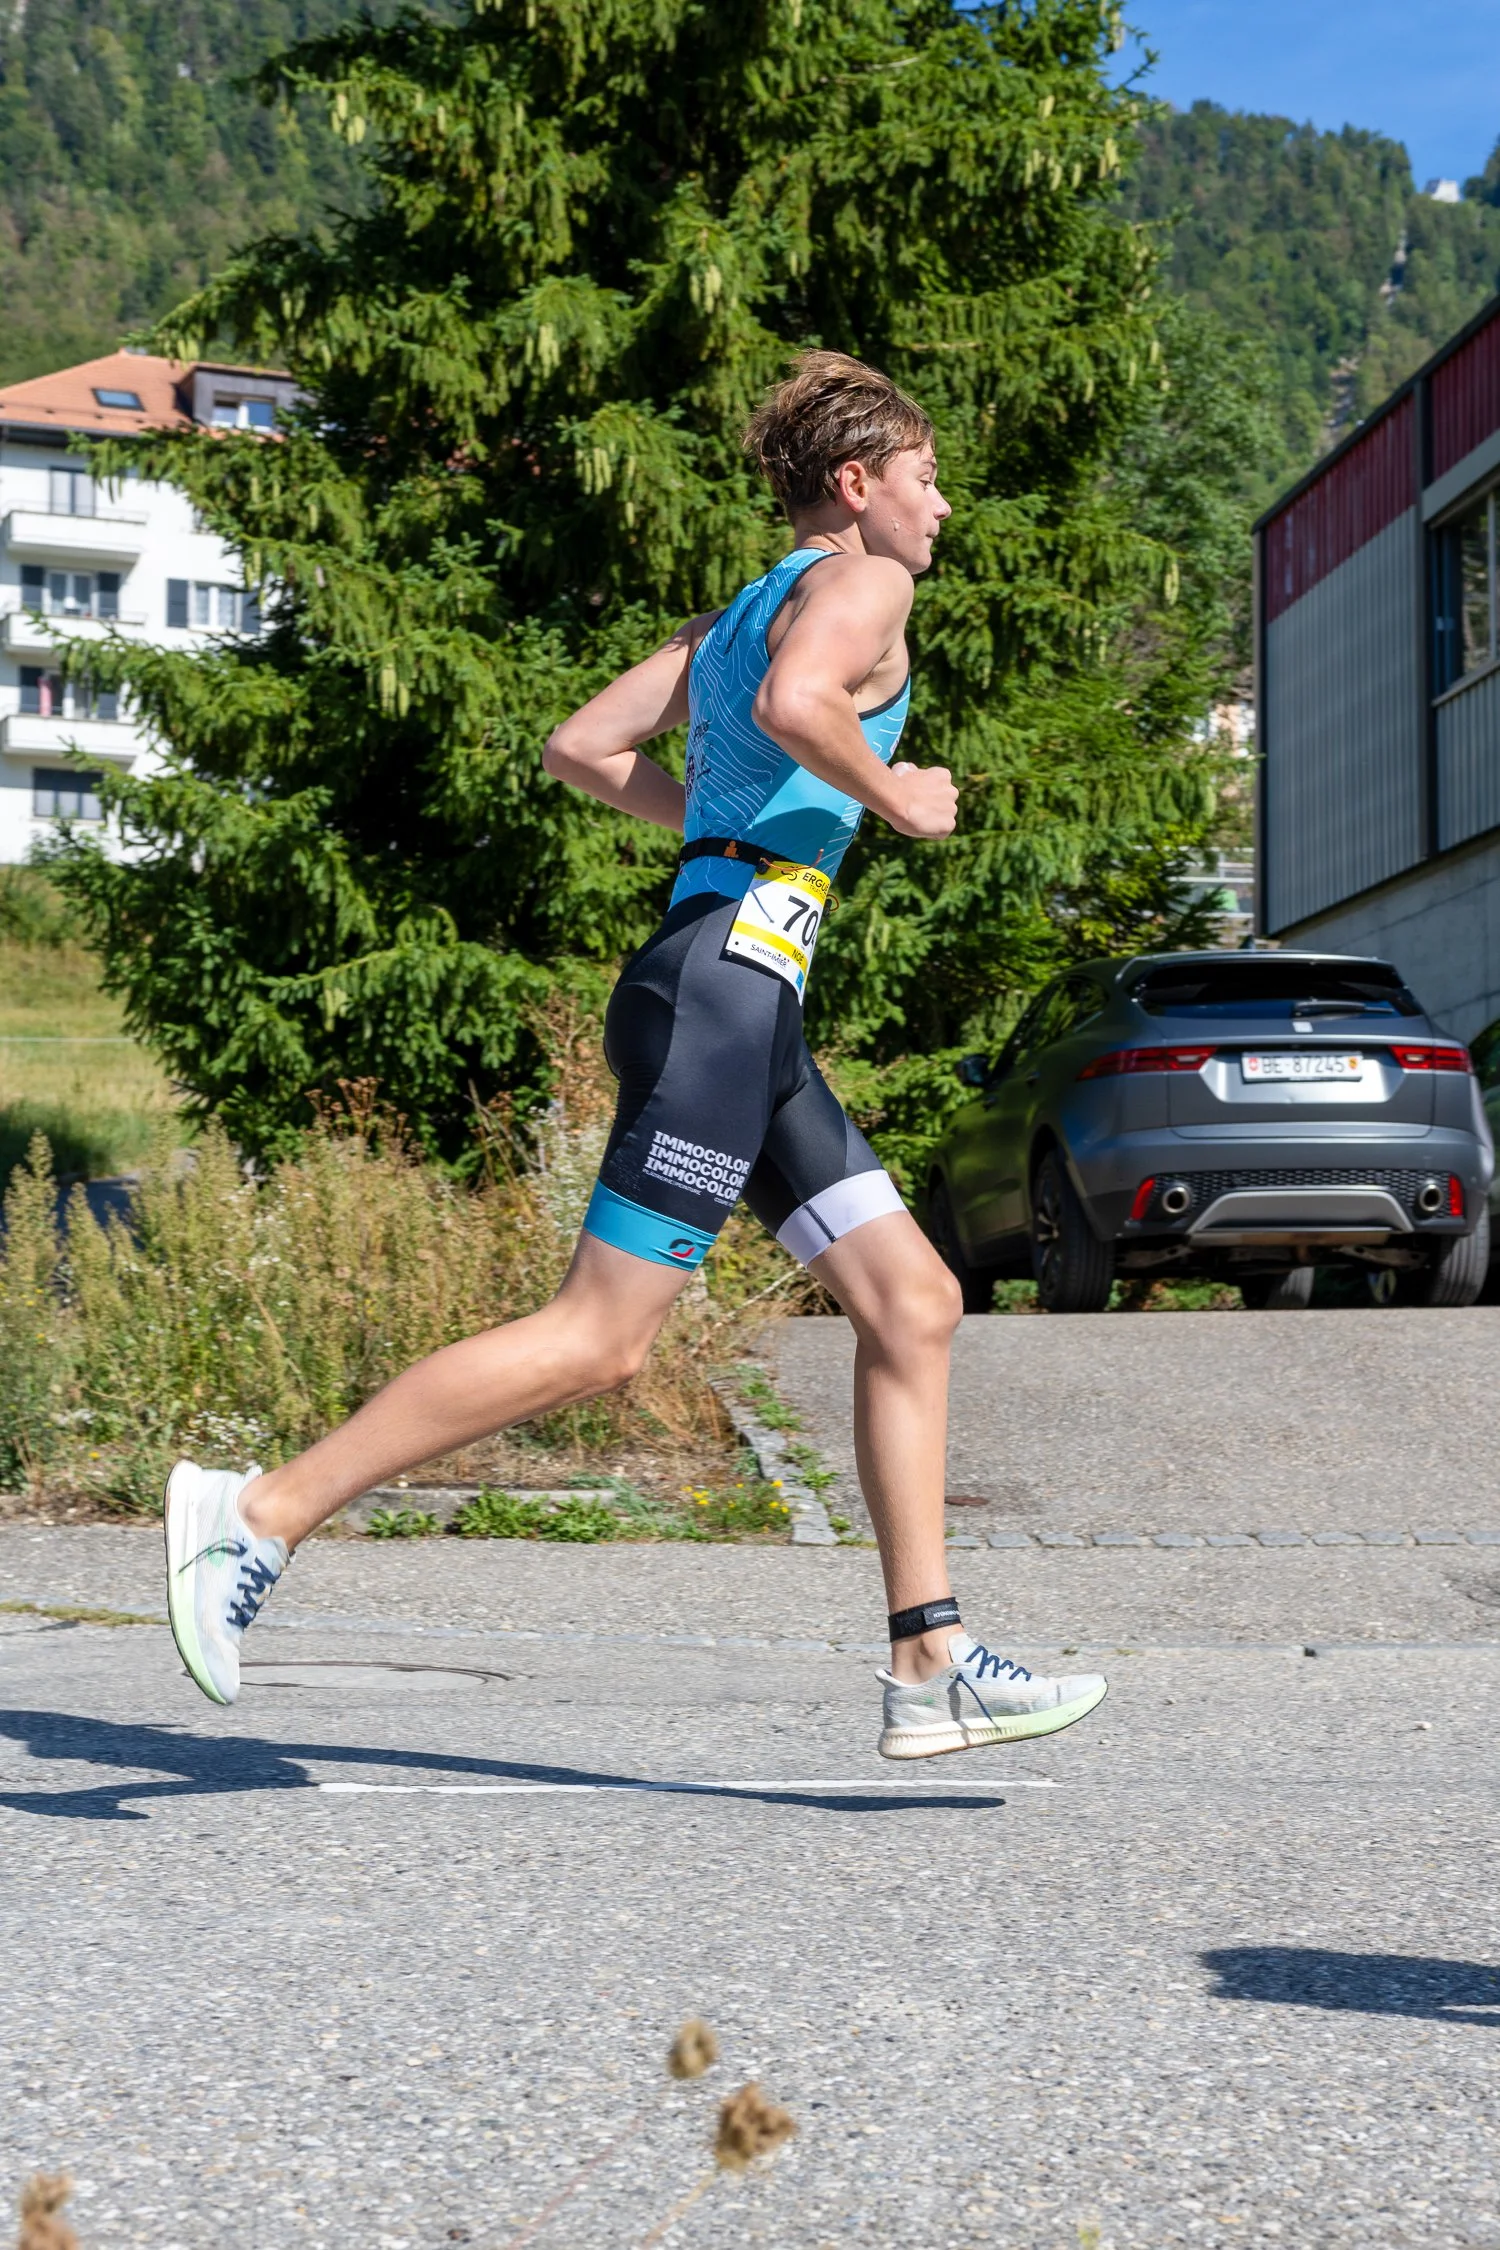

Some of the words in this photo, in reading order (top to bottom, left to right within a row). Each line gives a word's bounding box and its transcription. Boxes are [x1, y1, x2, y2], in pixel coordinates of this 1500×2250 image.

[782, 895, 816, 947] 70
[649, 1143, 746, 1188] IMMOCOLOR
[653, 1130, 750, 1174] IMMOCOLOR
[644, 1156, 740, 1202] IMMOCOLOR
